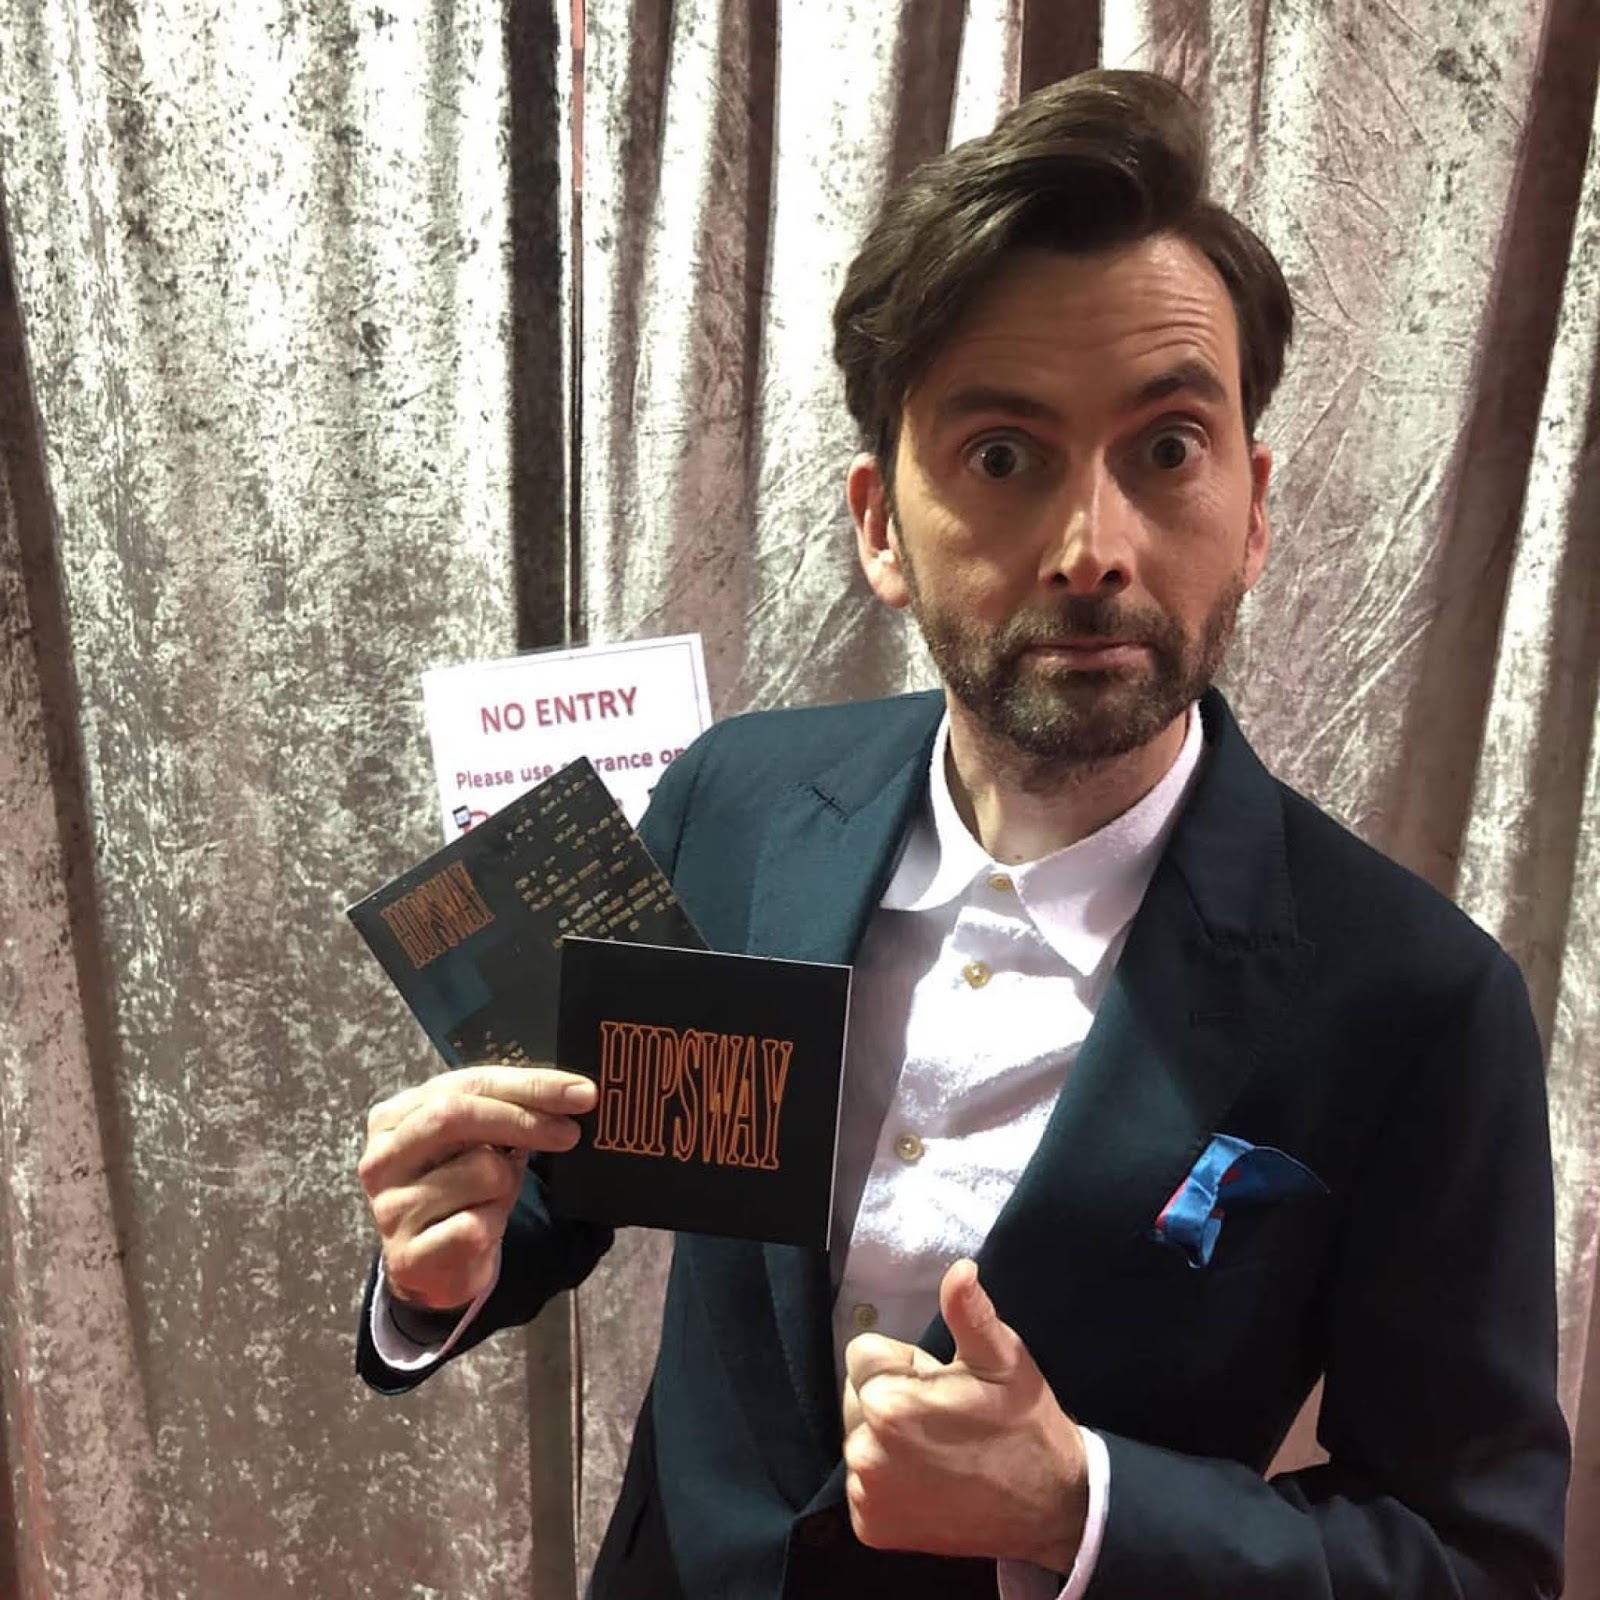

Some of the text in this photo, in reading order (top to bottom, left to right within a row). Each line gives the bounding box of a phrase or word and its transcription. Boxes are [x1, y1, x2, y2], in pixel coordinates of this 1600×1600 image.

[480, 686, 638, 734] NO ENTRY
[456, 770, 515, 790] Please
[520, 764, 554, 782] use
[560, 751, 653, 776] rance
[379, 860, 496, 969] HIPSWAY
[594, 1020, 794, 1170] HIPSWAY
